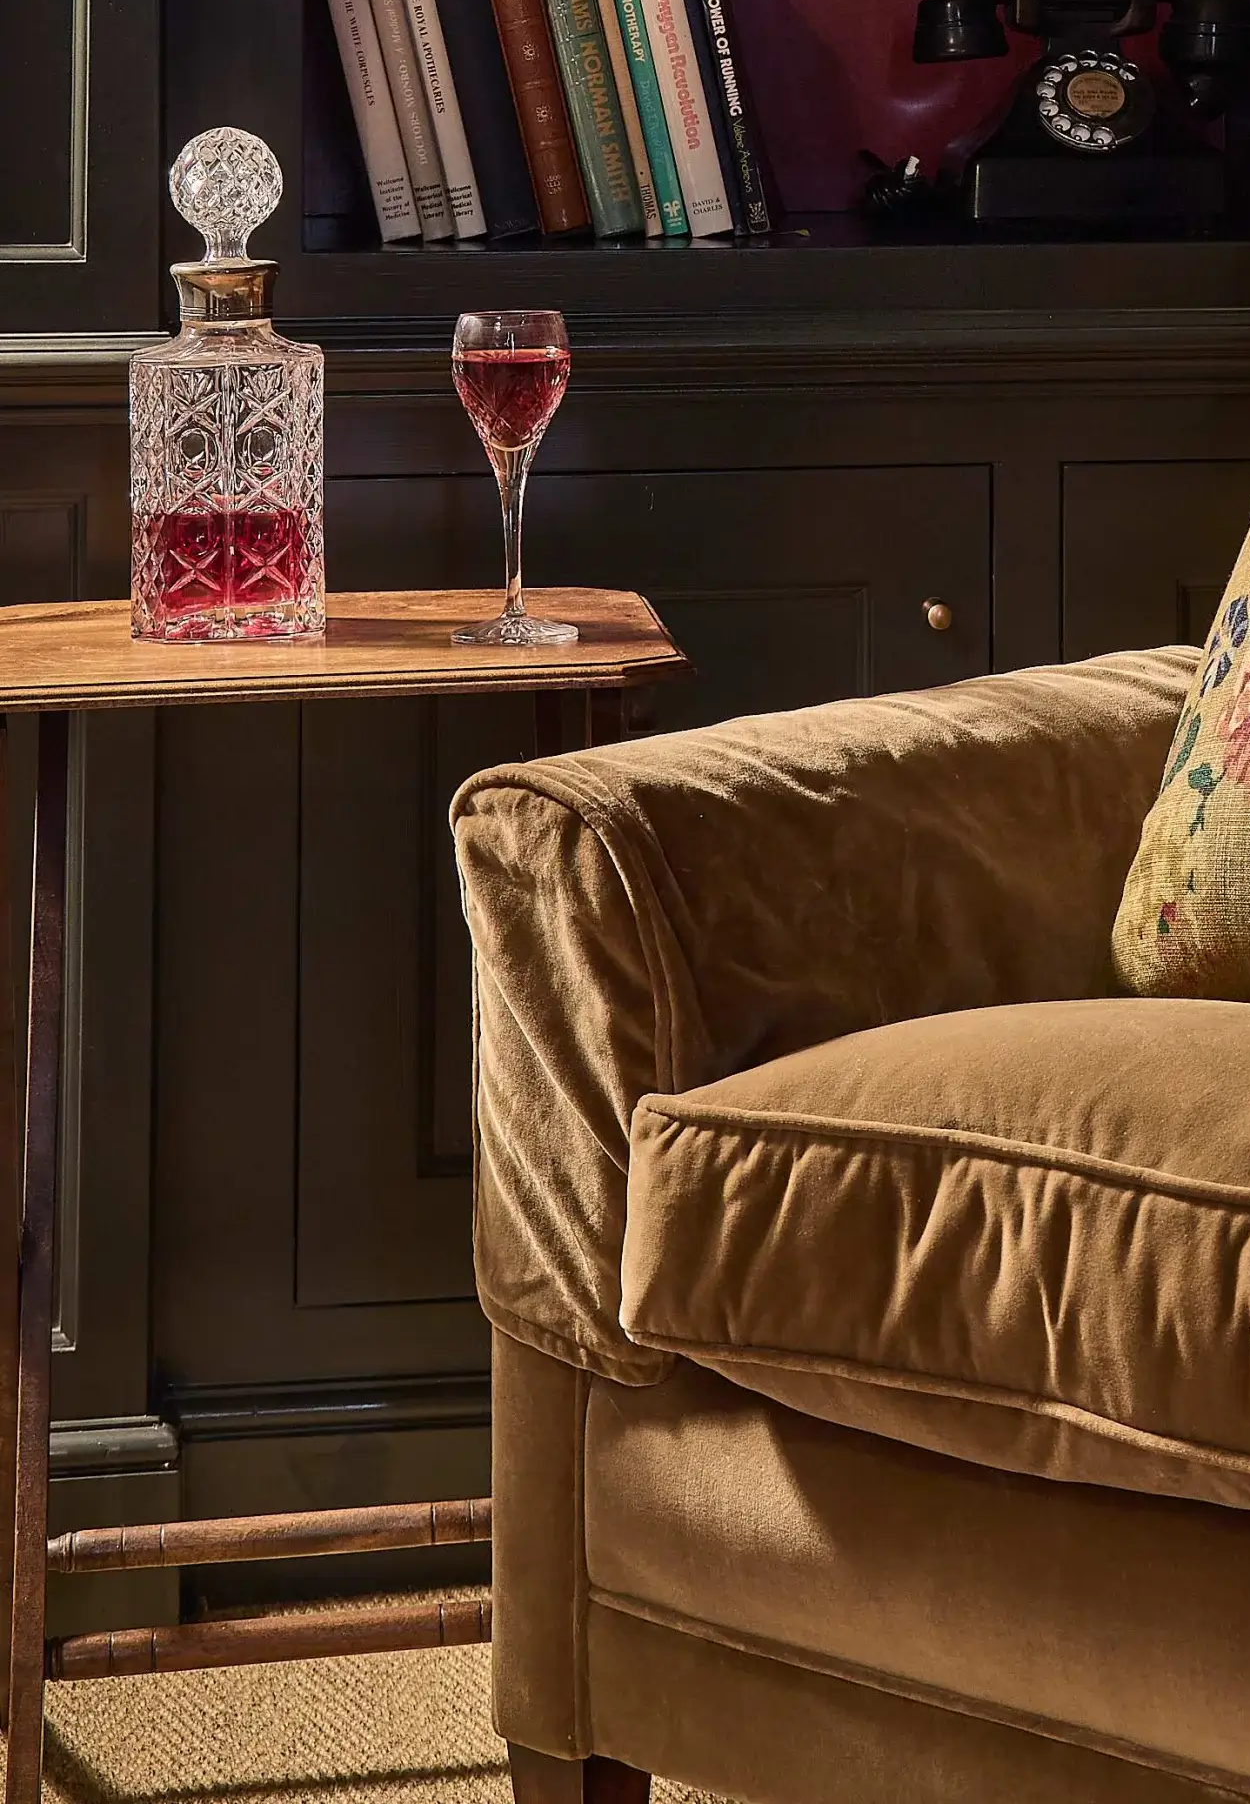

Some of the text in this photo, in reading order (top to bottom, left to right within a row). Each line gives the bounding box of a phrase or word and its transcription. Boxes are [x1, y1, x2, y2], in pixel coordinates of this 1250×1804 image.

[350, 16, 362, 48] WHITE
[357, 49, 376, 106] CORPUSCLES
[413, 5, 428, 39] ROYAL
[422, 42, 446, 115] APOTHECARIES
[716, 37, 731, 56] OF
[580, 40, 616, 138] NORMAN
[669, 54, 701, 150] Revolution
[719, 57, 743, 118] RUNNING
[640, 184, 657, 221] THOMAS
[692, 198, 714, 209] DAVID
[693, 204, 723, 216] CHARLES
